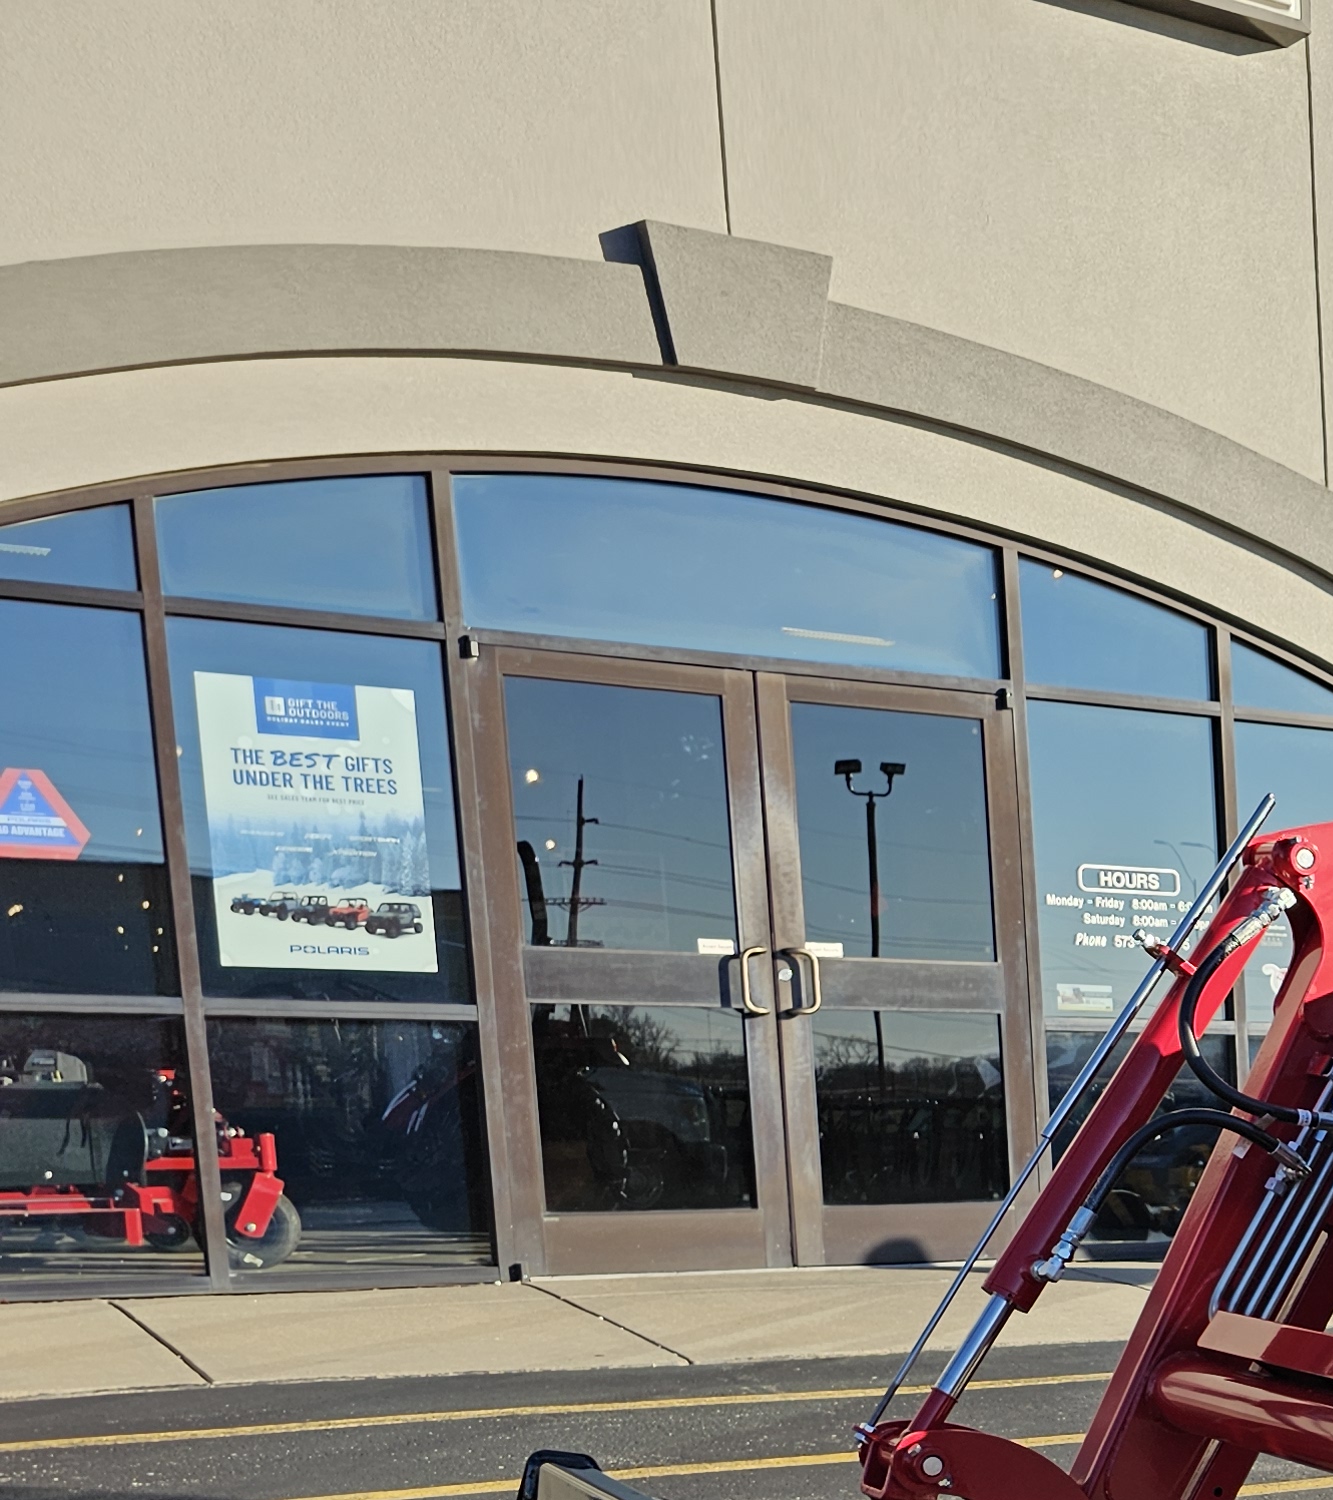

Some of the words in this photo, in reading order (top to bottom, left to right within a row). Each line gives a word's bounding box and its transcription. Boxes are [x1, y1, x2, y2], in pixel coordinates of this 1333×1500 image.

[288, 698, 313, 709] GIFT
[316, 700, 337, 711] THE
[288, 708, 349, 721] OUTDOORS
[230, 747, 266, 766] THE
[270, 750, 340, 770] BEST
[344, 756, 393, 775] GIFTS
[232, 768, 294, 789] UNDER
[300, 773, 336, 791] THE
[341, 776, 398, 795] TREES
[1099, 870, 1160, 890] HOURS
[1046, 893, 1084, 909] Monday
[1095, 896, 1125, 911] Friday
[1131, 898, 1168, 912] 8:00am
[1082, 912, 1126, 928] Saturday
[1132, 914, 1168, 928] 8:00am
[1074, 932, 1108, 947] Phone
[289, 944, 370, 956] POLARIS
